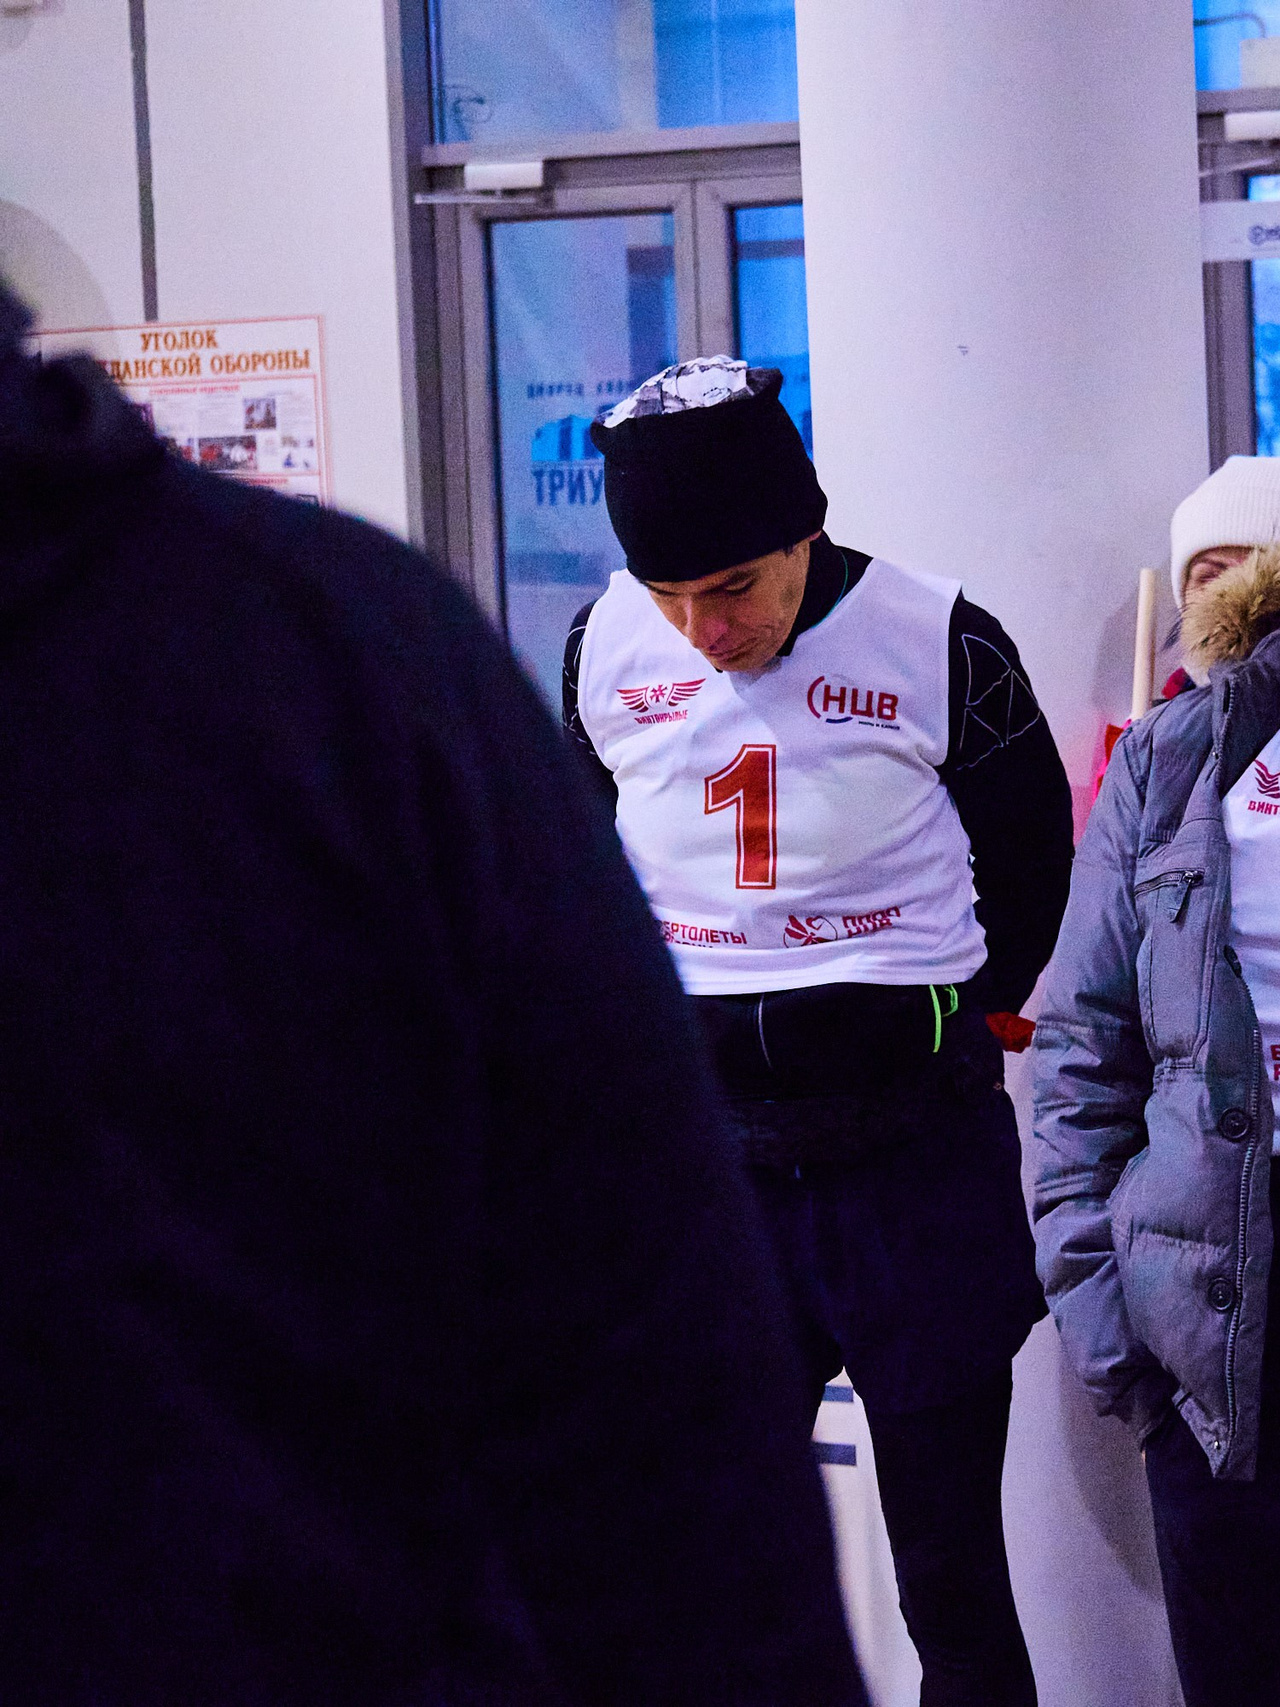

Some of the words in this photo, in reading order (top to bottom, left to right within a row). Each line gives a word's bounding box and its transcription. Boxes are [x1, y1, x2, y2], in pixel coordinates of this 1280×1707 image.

[140, 329, 218, 351] УГОЛОК
[209, 349, 310, 375] ОБОРОНЫ
[822, 684, 899, 721] НЦВ
[704, 744, 777, 890] 1
